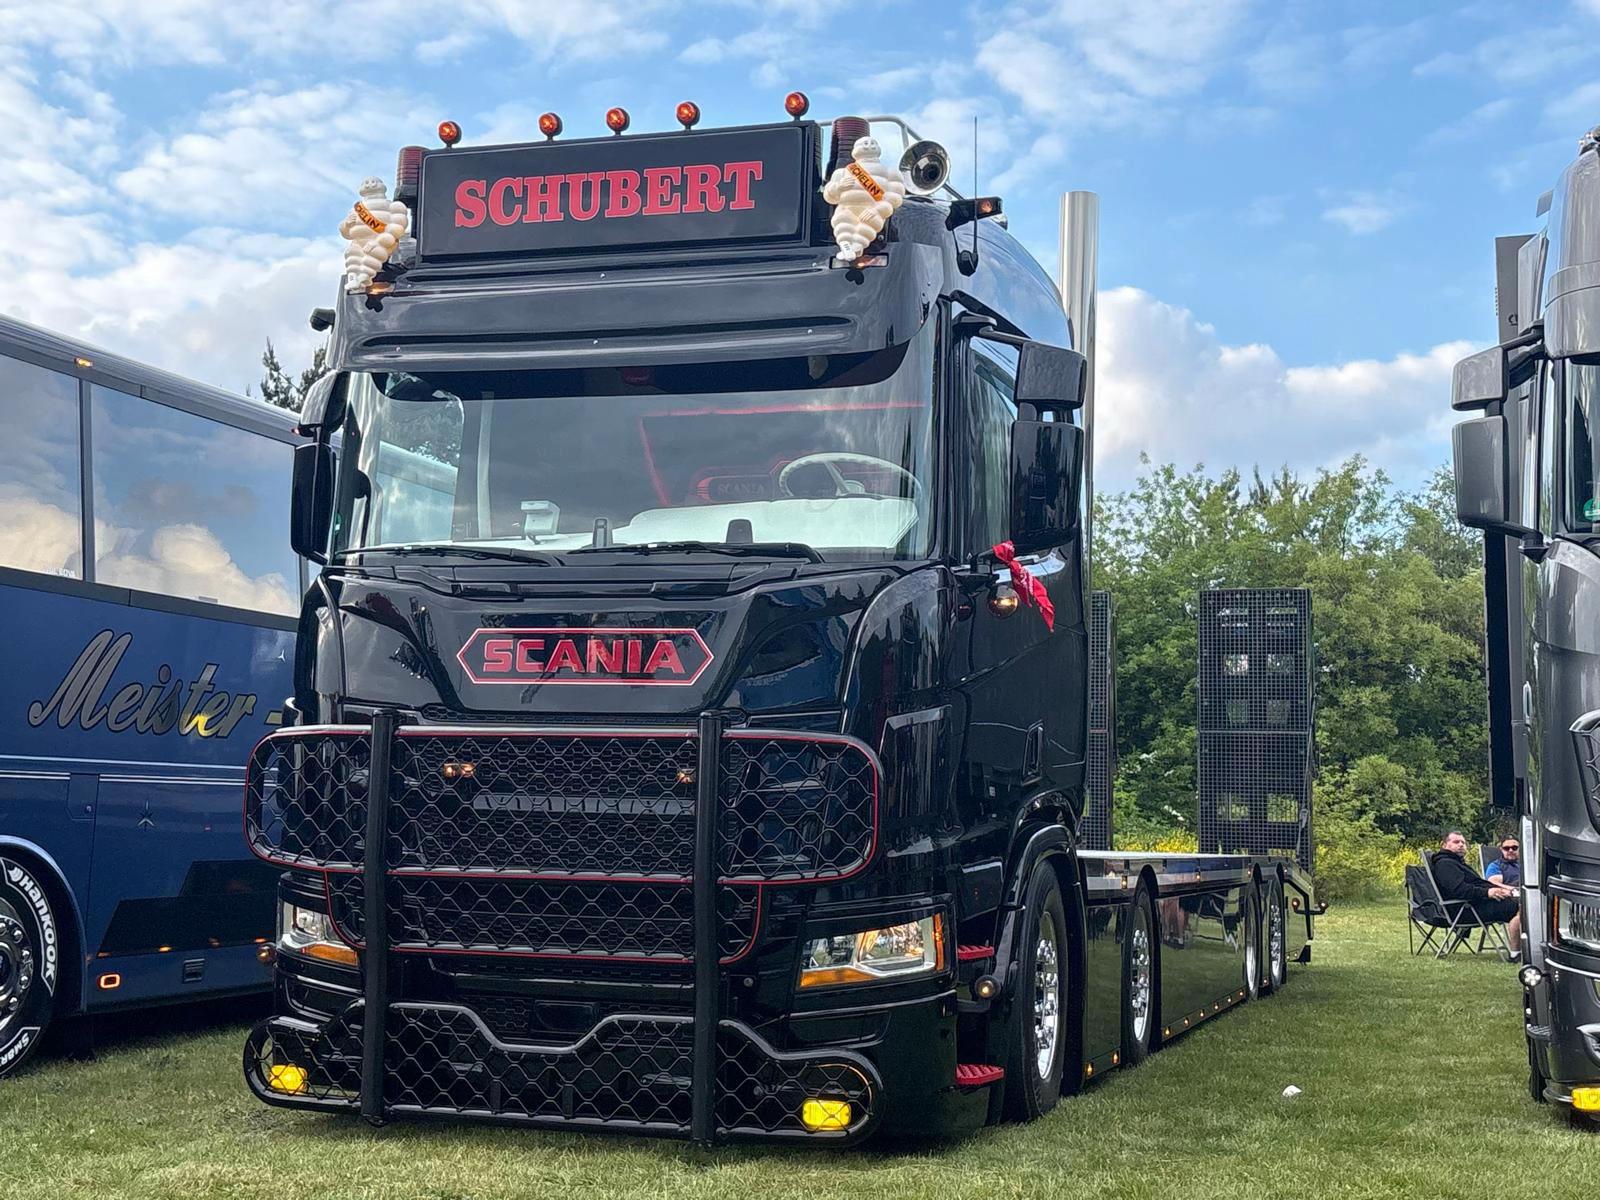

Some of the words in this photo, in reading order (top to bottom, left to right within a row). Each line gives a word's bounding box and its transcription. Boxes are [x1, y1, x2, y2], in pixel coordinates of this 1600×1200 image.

[454, 160, 763, 228] SCHUBERT
[28, 628, 257, 738] Meister
[483, 639, 686, 674] SCANIA
